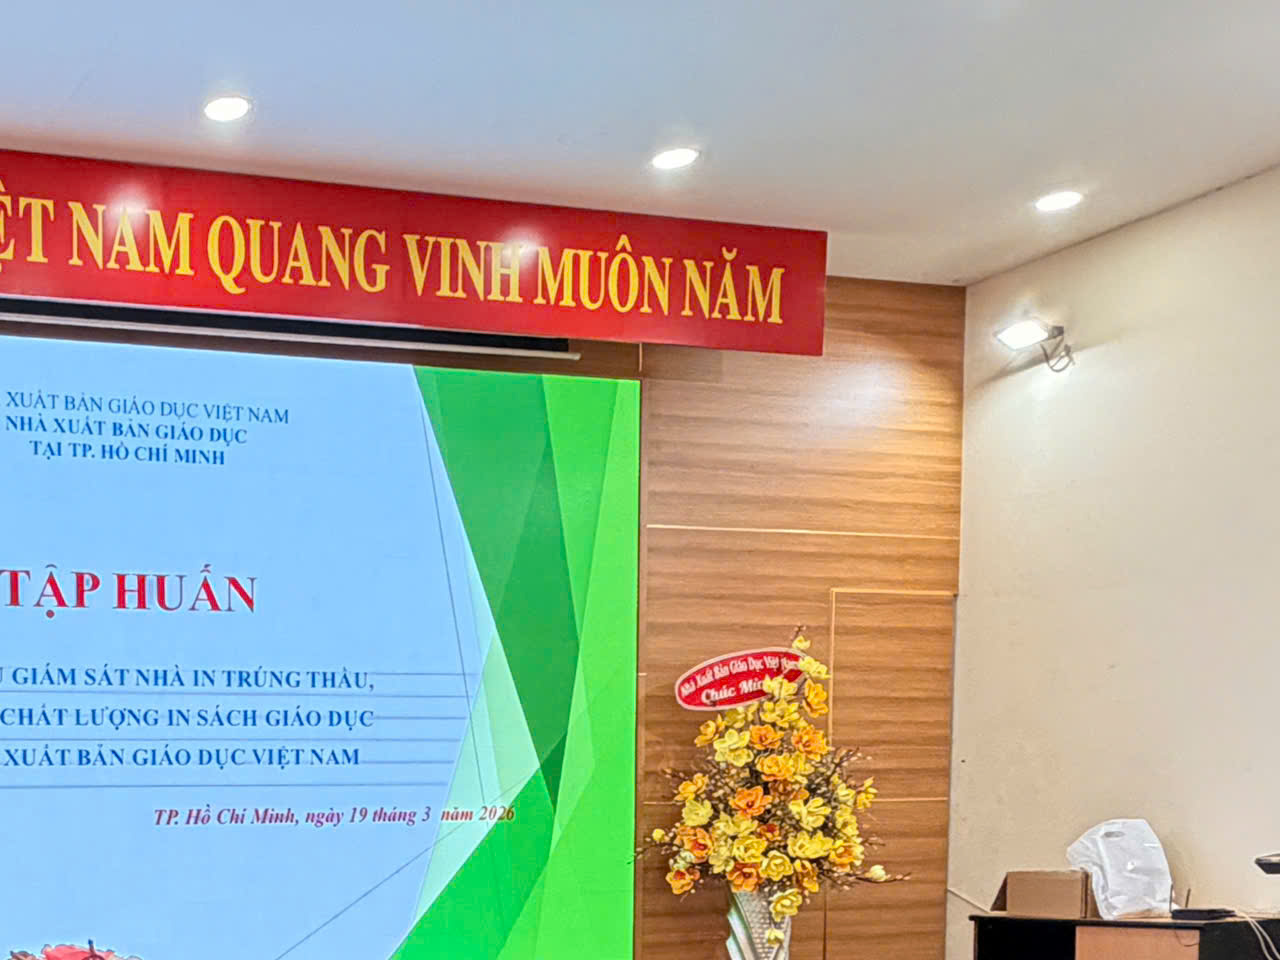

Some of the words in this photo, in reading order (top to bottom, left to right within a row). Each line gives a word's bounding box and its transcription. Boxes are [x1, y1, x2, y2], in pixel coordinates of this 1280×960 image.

[68, 202, 195, 277] NAM
[207, 214, 391, 295] QUANG
[404, 233, 524, 304] VINH
[535, 234, 673, 316] MUÔN
[681, 251, 785, 325] NĂM
[6, 389, 59, 410] XUẤT
[64, 392, 103, 412] BẢN
[108, 395, 155, 416] GIÁO
[161, 401, 198, 420] DỤC
[204, 403, 244, 423] VIỆT
[248, 407, 289, 424] NAM
[6, 412, 47, 433] NHÀ
[53, 415, 106, 435] XUẤT
[112, 418, 150, 438] BẢN
[156, 421, 203, 441] GIÁO
[209, 427, 248, 447] DỤC
[29, 440, 62, 461] TẠI
[68, 442, 95, 459] TP.
[134, 443, 168, 463] CHÍ
[174, 448, 225, 465] MINH
[112, 563, 260, 613] HUẤN
[12, 662, 77, 686] GIÁM
[84, 663, 130, 686] SÁT
[135, 664, 185, 687] NHÀ
[193, 669, 216, 687] IN
[221, 665, 301, 688] TRÚNG
[701, 685, 737, 705] Chúc
[0, 703, 69, 726] CHẤT
[75, 706, 159, 730] LƯỢNG
[168, 708, 191, 726] IN
[196, 704, 257, 727] SÁCH
[265, 705, 322, 727] GIÁO
[328, 710, 375, 731] DỤC
[4, 743, 71, 767] XUẤT
[77, 743, 125, 766] BẢN
[132, 743, 191, 766] GIÁO
[198, 748, 246, 770] DỤC
[252, 745, 305, 770] VIỆT
[310, 748, 360, 766] NAM
[154, 808, 179, 826] TP.
[184, 803, 211, 825] Hồ
[216, 807, 247, 825] Chí
[250, 807, 299, 826] Minh,
[305, 807, 345, 828] ngày
[349, 807, 368, 823] 19
[372, 806, 417, 826] tháng
[421, 805, 432, 822] 3
[440, 807, 474, 821] năm
[478, 805, 516, 821] 2026
